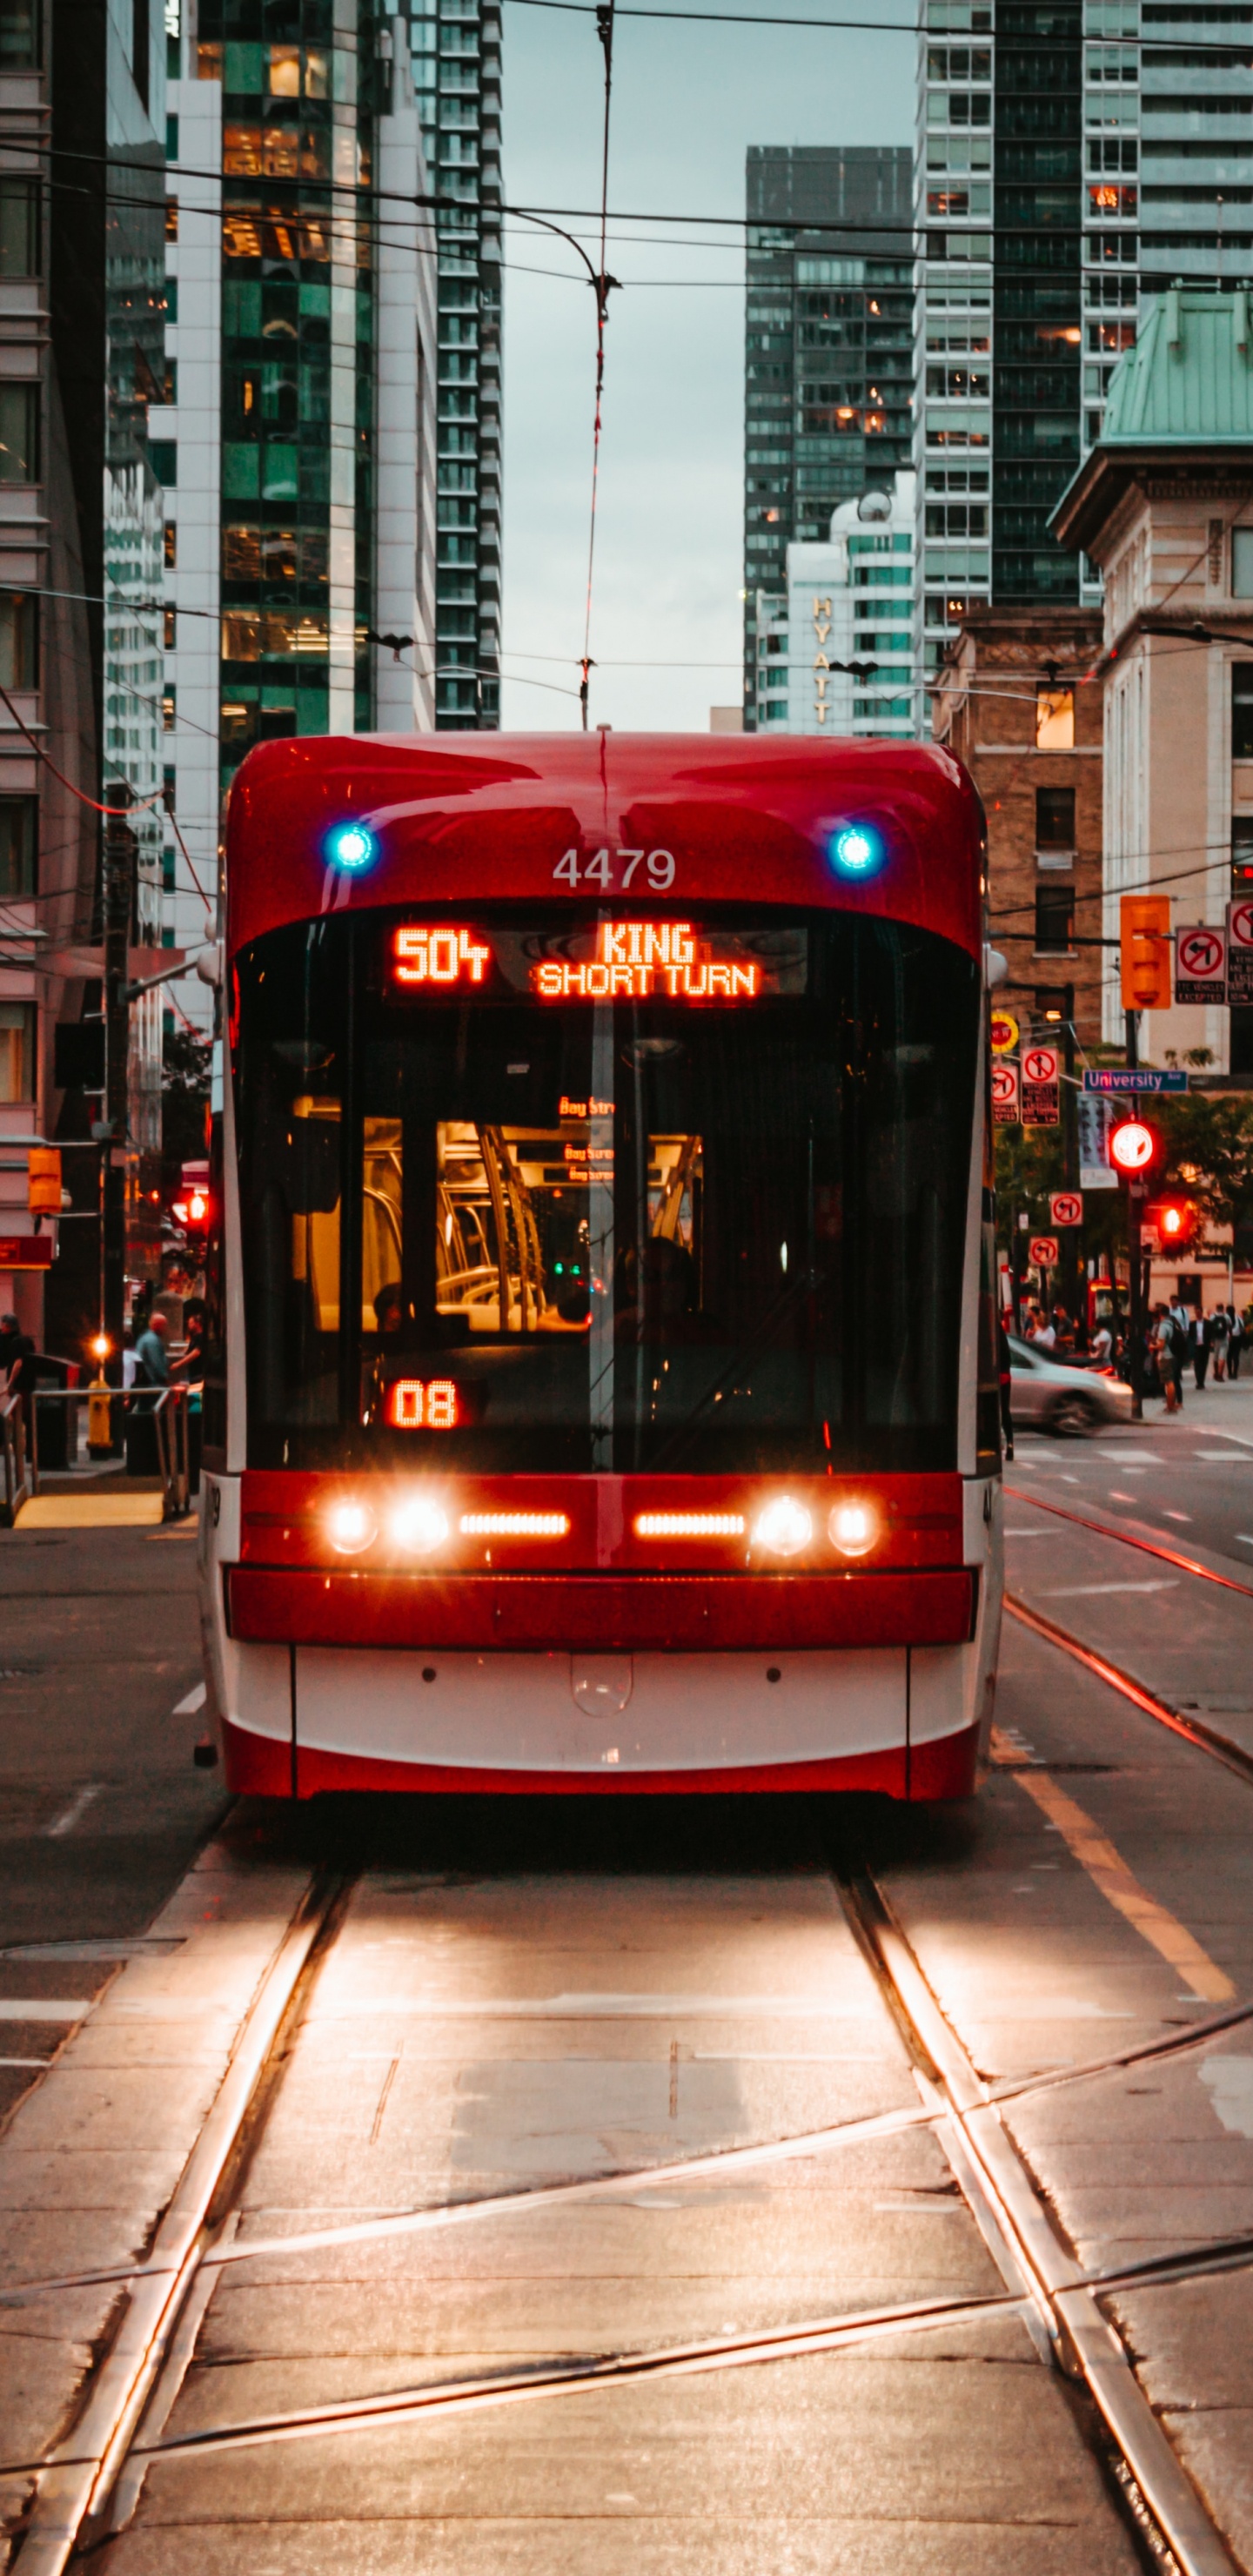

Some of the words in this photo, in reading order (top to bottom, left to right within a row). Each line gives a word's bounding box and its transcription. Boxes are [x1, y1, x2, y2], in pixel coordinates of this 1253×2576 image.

[813, 597, 832, 724] HYATT
[553, 849, 676, 889] 4479
[396, 928, 489, 982] 504
[603, 922, 694, 963] KING
[538, 963, 654, 996] SHORT
[664, 963, 757, 996] TURN
[1179, 993, 1223, 1002] EXCEPTED
[1089, 1072, 1163, 1090] University
[559, 1097, 586, 1117] Bay
[396, 1380, 455, 1427] 08
